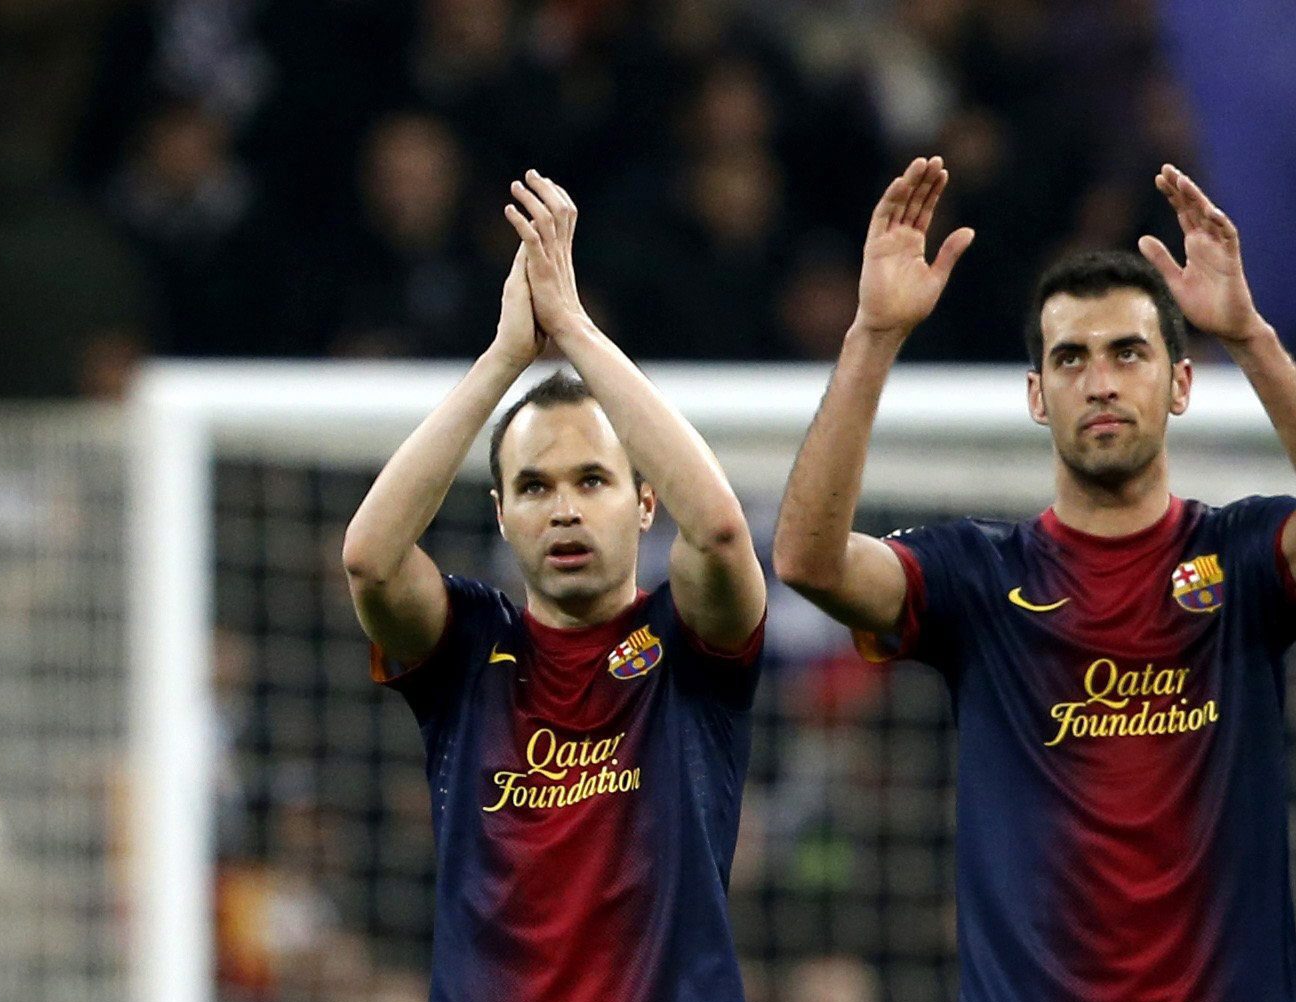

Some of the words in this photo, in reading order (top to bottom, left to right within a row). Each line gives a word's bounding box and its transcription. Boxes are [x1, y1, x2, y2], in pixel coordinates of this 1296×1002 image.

[1084, 658, 1191, 710] Qatar
[1043, 697, 1220, 747] Foundation
[526, 728, 626, 781] Qatar
[482, 758, 641, 813] Foundation
